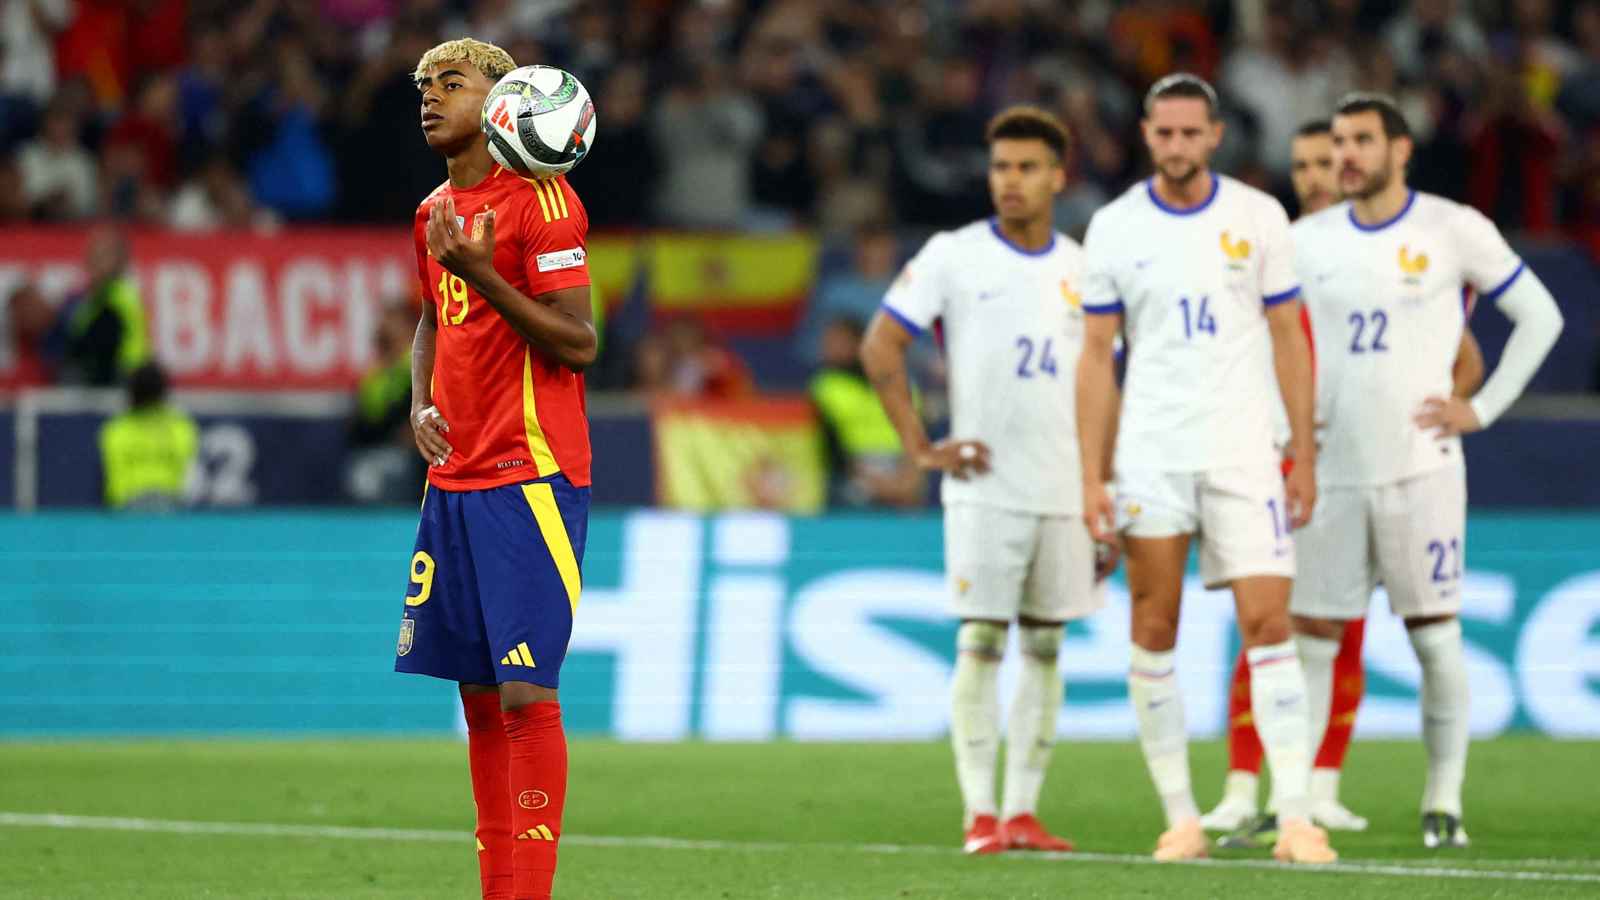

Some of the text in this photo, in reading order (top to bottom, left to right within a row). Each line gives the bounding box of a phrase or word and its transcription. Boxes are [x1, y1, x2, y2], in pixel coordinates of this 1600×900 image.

[439, 271, 469, 326] 19
[1179, 297, 1217, 339] 14
[1349, 310, 1388, 353] 22
[1016, 336, 1057, 379] 24
